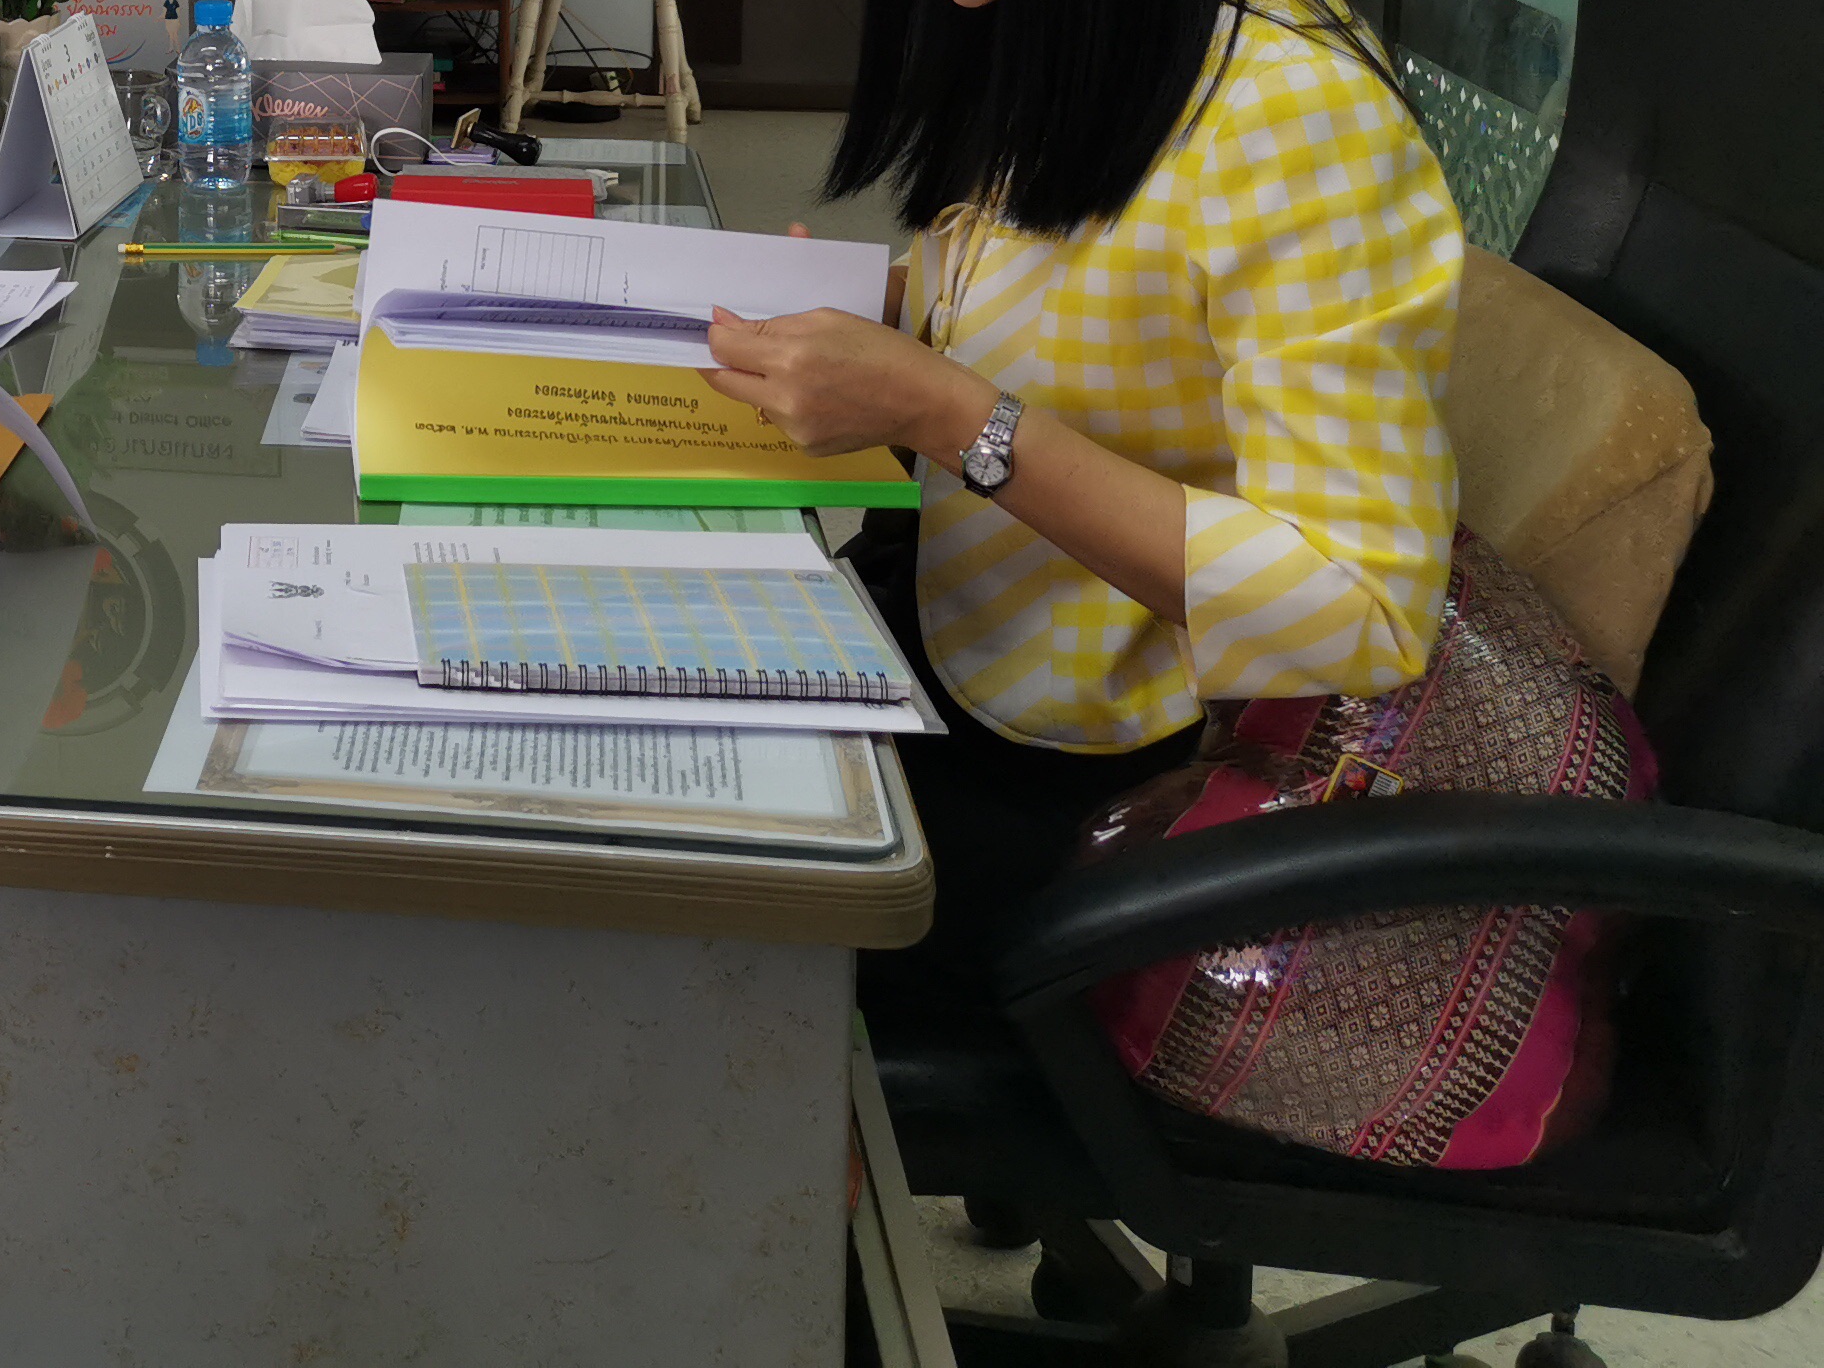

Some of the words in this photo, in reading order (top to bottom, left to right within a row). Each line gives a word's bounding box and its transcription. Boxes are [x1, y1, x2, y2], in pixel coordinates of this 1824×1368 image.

[534, 384, 617, 407] จังหวัดระยอง
[627, 392, 699, 413] อำเภอแกลง
